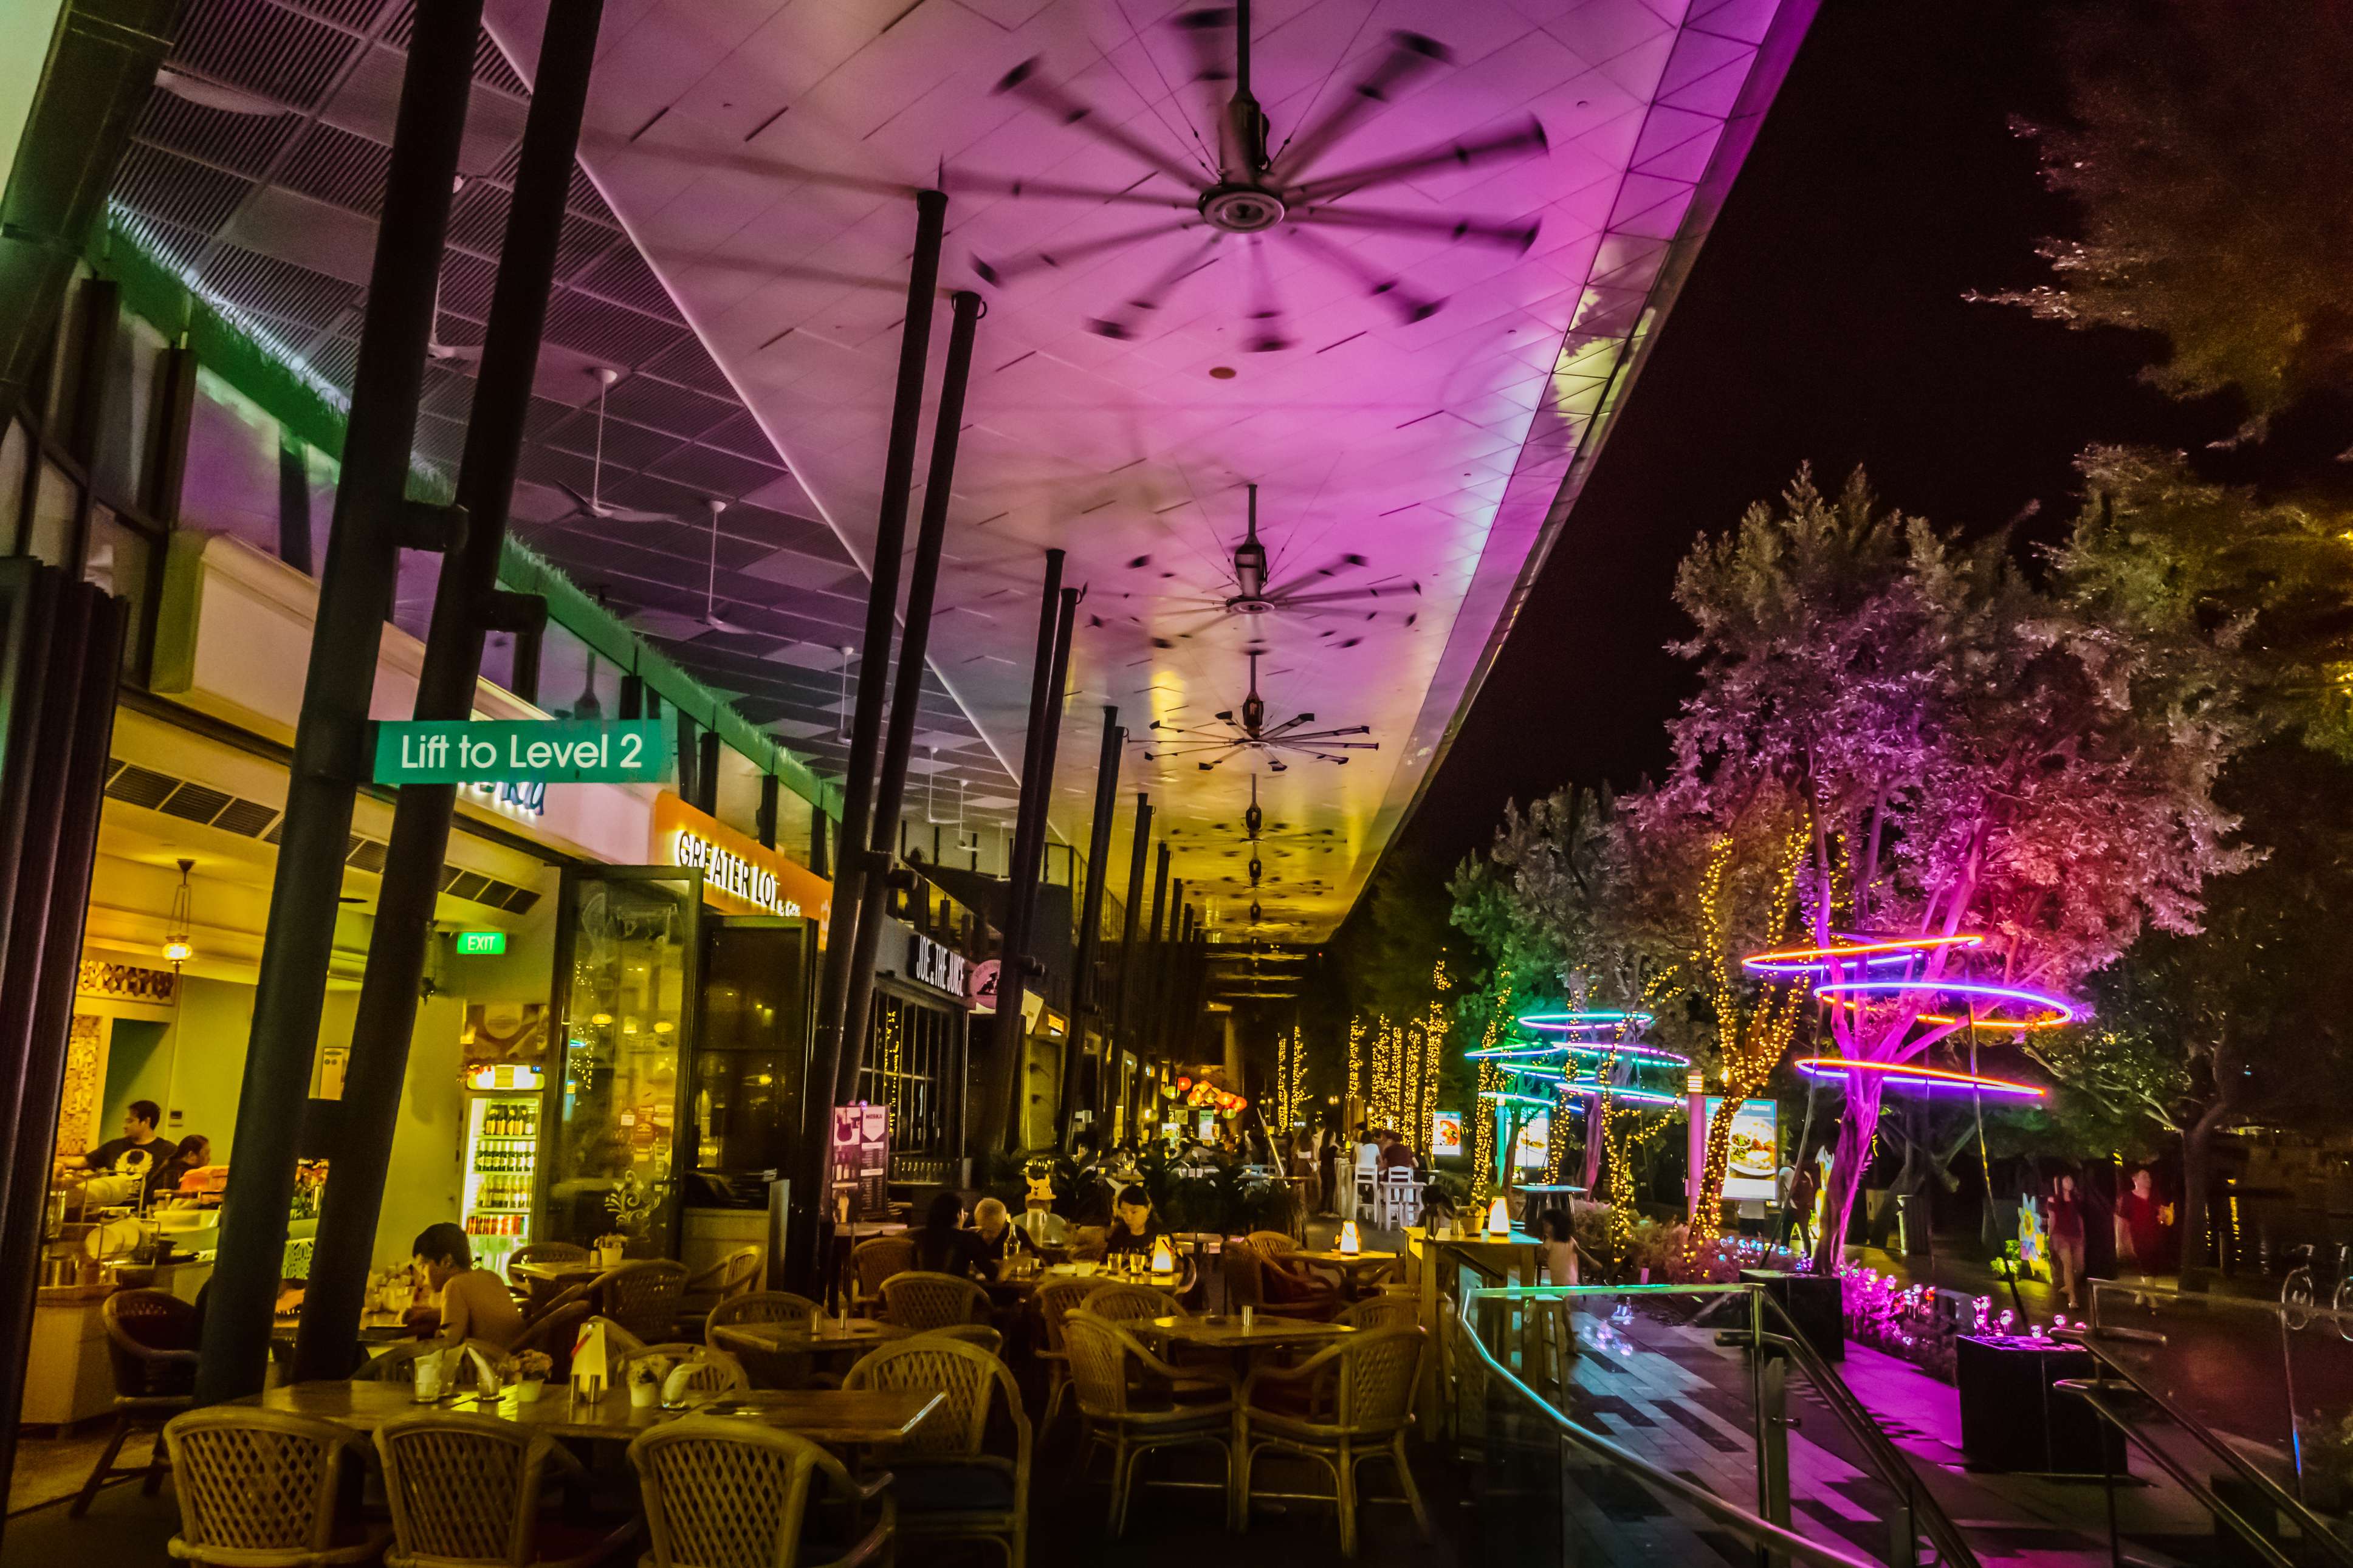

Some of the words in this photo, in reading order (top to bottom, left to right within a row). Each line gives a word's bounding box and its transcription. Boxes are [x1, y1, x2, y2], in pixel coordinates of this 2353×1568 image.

[401, 734, 450, 769] Lift
[459, 734, 497, 769] to
[510, 733, 608, 769] Level
[619, 733, 643, 769] 2
[674, 830, 750, 899] GREATER
[467, 936, 495, 951] EXIT
[916, 934, 932, 982] JOE
[930, 970, 935, 985] &
[935, 942, 947, 990] THE
[947, 951, 965, 997] JUICE
